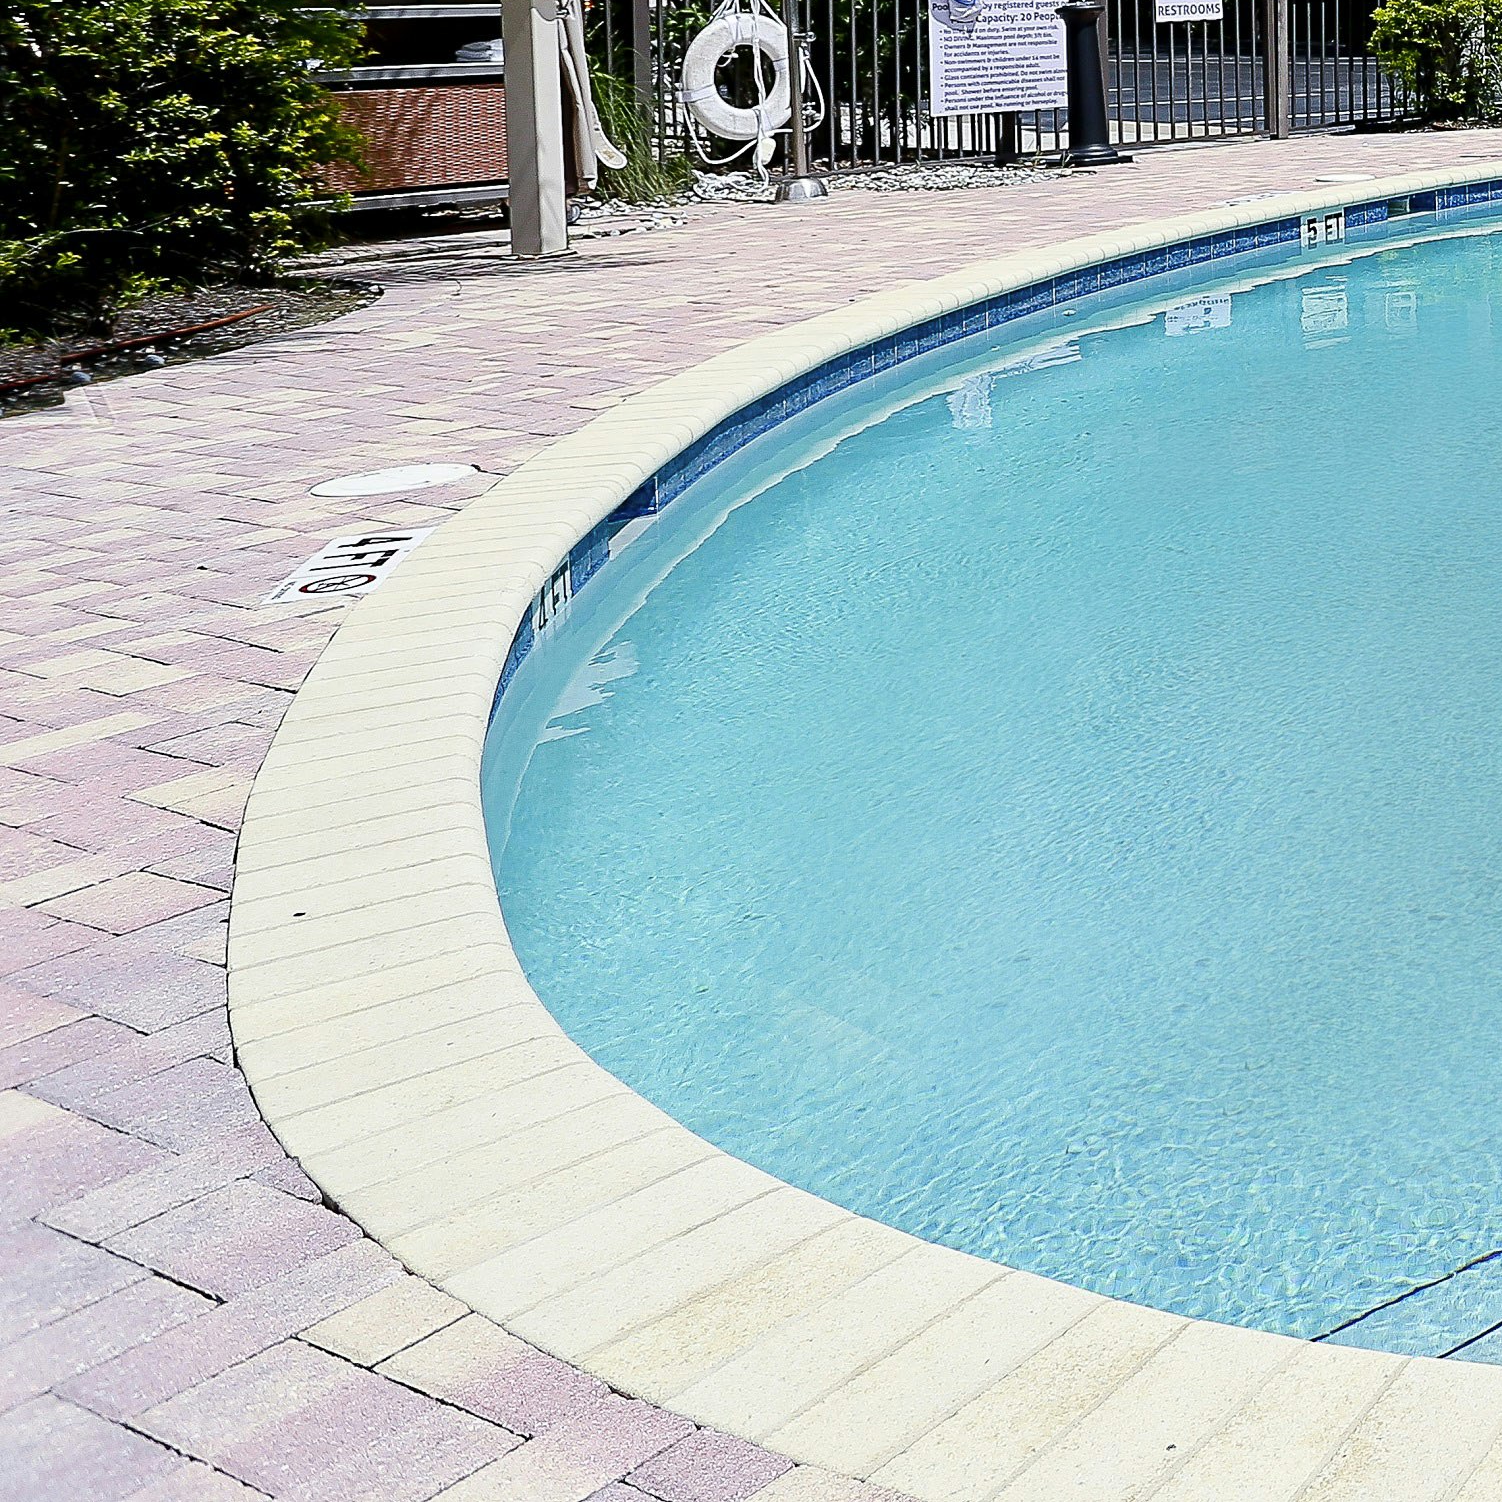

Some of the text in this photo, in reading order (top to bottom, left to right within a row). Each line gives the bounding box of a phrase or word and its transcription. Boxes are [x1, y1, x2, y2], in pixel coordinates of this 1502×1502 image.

[994, 1, 1034, 10] registered
[1035, 1, 1059, 9] guests
[1158, 3, 1222, 16] RESTROOMS
[976, 13, 1018, 25] Capacity:
[1020, 13, 1031, 21] 20
[1307, 217, 1317, 247] 5
[308, 536, 413, 572] 4 FT
[539, 559, 569, 631] 4 FT
